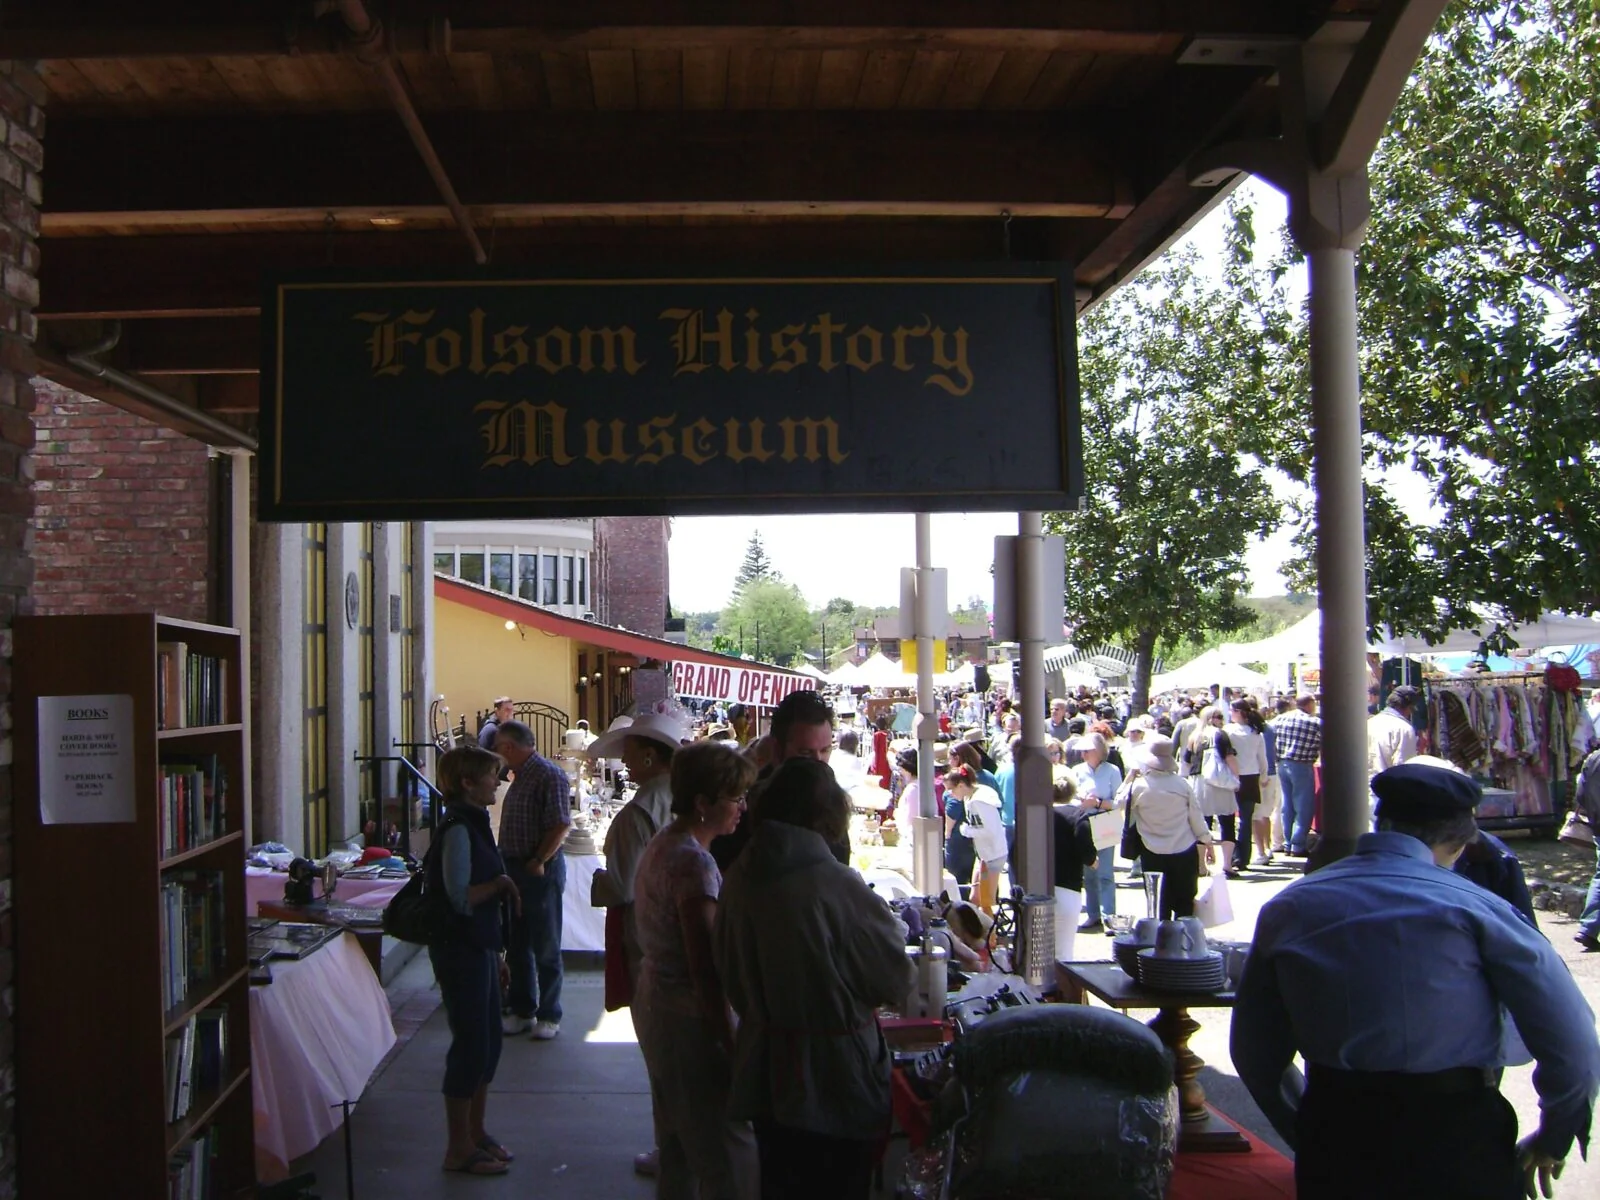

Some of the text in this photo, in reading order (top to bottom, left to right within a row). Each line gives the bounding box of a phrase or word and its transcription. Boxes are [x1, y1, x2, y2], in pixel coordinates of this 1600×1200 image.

[354, 306, 975, 397] Folsom History
[472, 399, 850, 470] Museum
[673, 662, 731, 699] GRAND
[67, 709, 109, 719] BOOKS
[62, 734, 85, 742] HARD
[60, 742, 118, 751] COVER BOOKS
[64, 773, 114, 781] PAPERBACK
